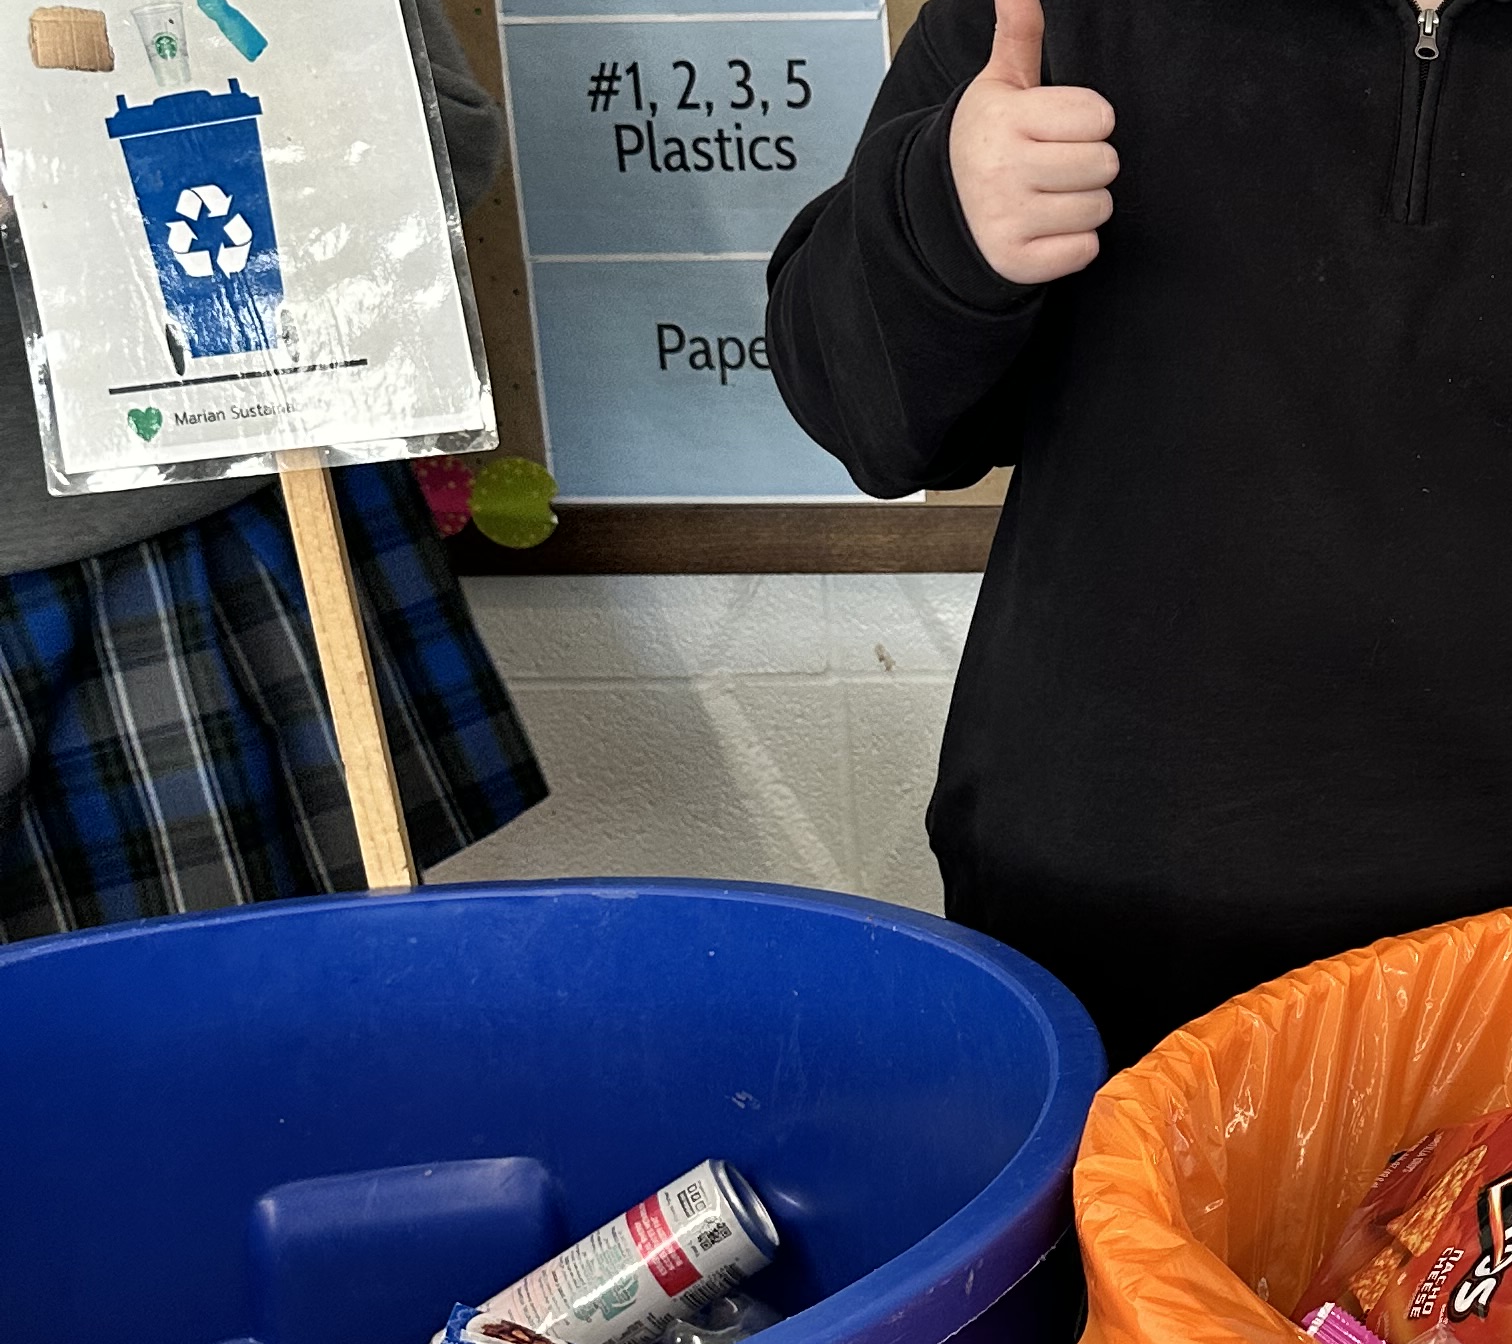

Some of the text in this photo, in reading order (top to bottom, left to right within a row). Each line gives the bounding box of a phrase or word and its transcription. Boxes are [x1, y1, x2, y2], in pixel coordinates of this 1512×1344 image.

[587, 58, 812, 115] #1, 2, 3, 5
[614, 120, 798, 174] Plastics
[657, 323, 771, 386] Pape
[174, 408, 226, 426] Marian
[1410, 1247, 1454, 1318] CHEESE
